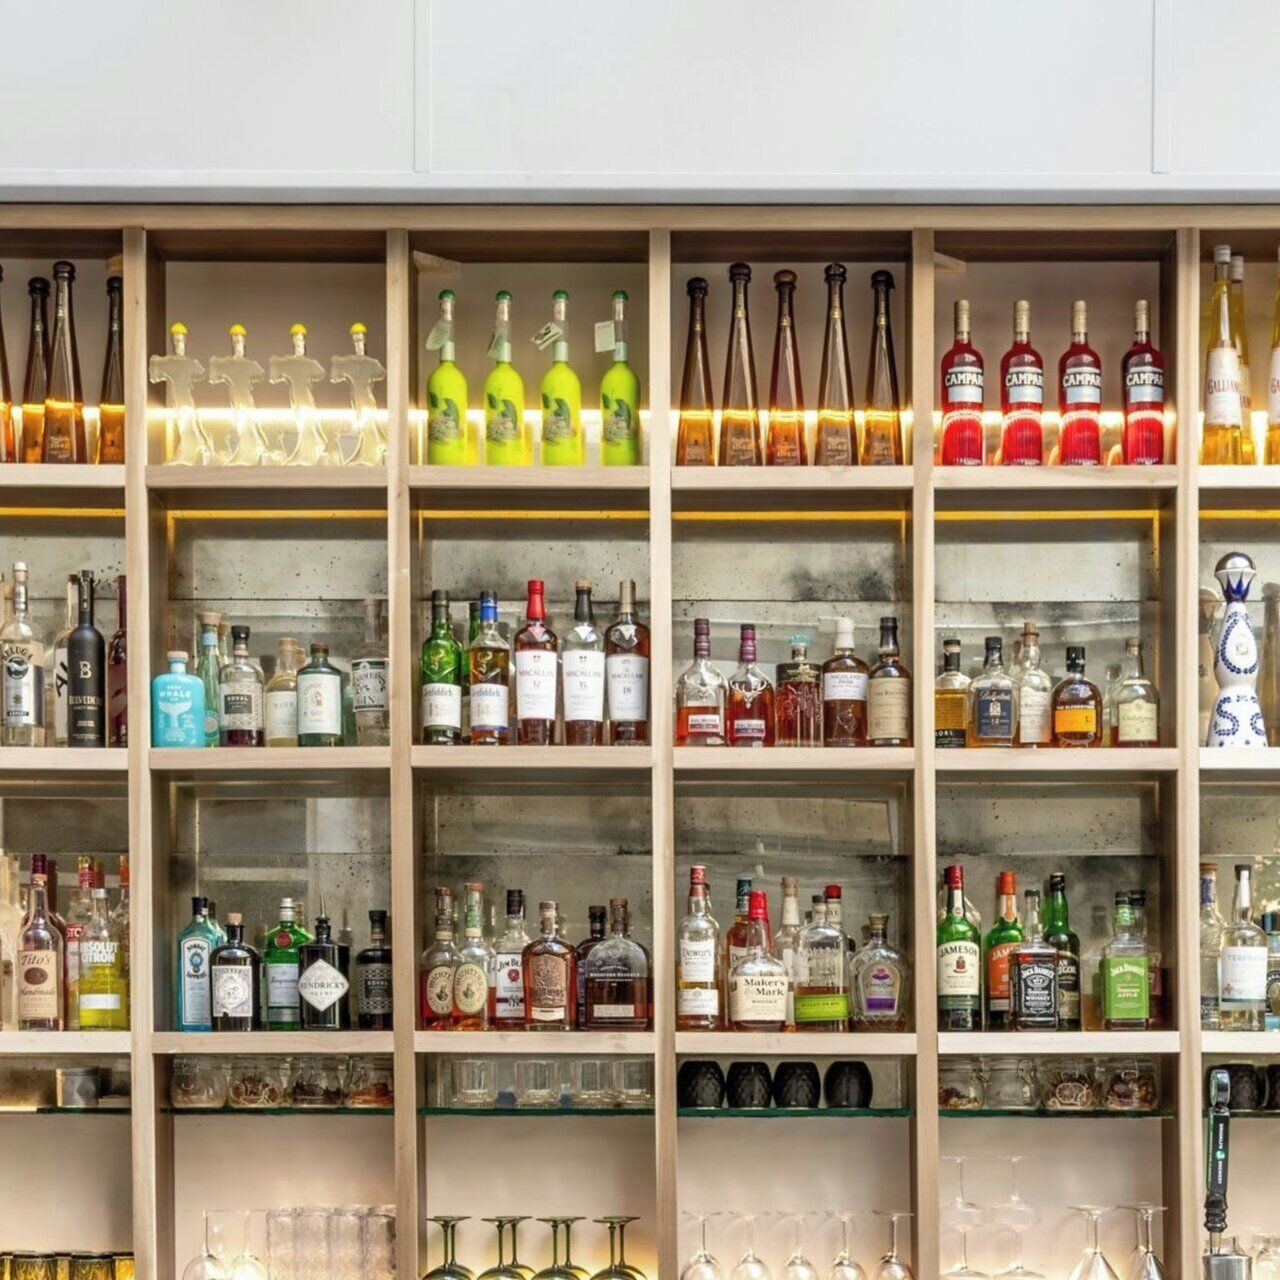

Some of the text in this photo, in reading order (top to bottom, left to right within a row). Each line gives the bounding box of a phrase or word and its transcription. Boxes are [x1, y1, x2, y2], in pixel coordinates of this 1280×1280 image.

[945, 372, 984, 388] CAMPAR
[1005, 372, 1043, 388] CAMPAR
[1063, 372, 1102, 388] CAMPAR
[1126, 371, 1164, 388] CAMPAR
[1207, 378, 1239, 395] GALLIAN
[159, 690, 192, 699] WHALE
[682, 947, 713, 959] Dewar's
[938, 946, 978, 958] JAMESON
[20, 952, 50, 965] Tito's
[299, 981, 345, 990] HENDRICK'S
[743, 976, 785, 987] Maker's
[755, 986, 785, 998] Mark
